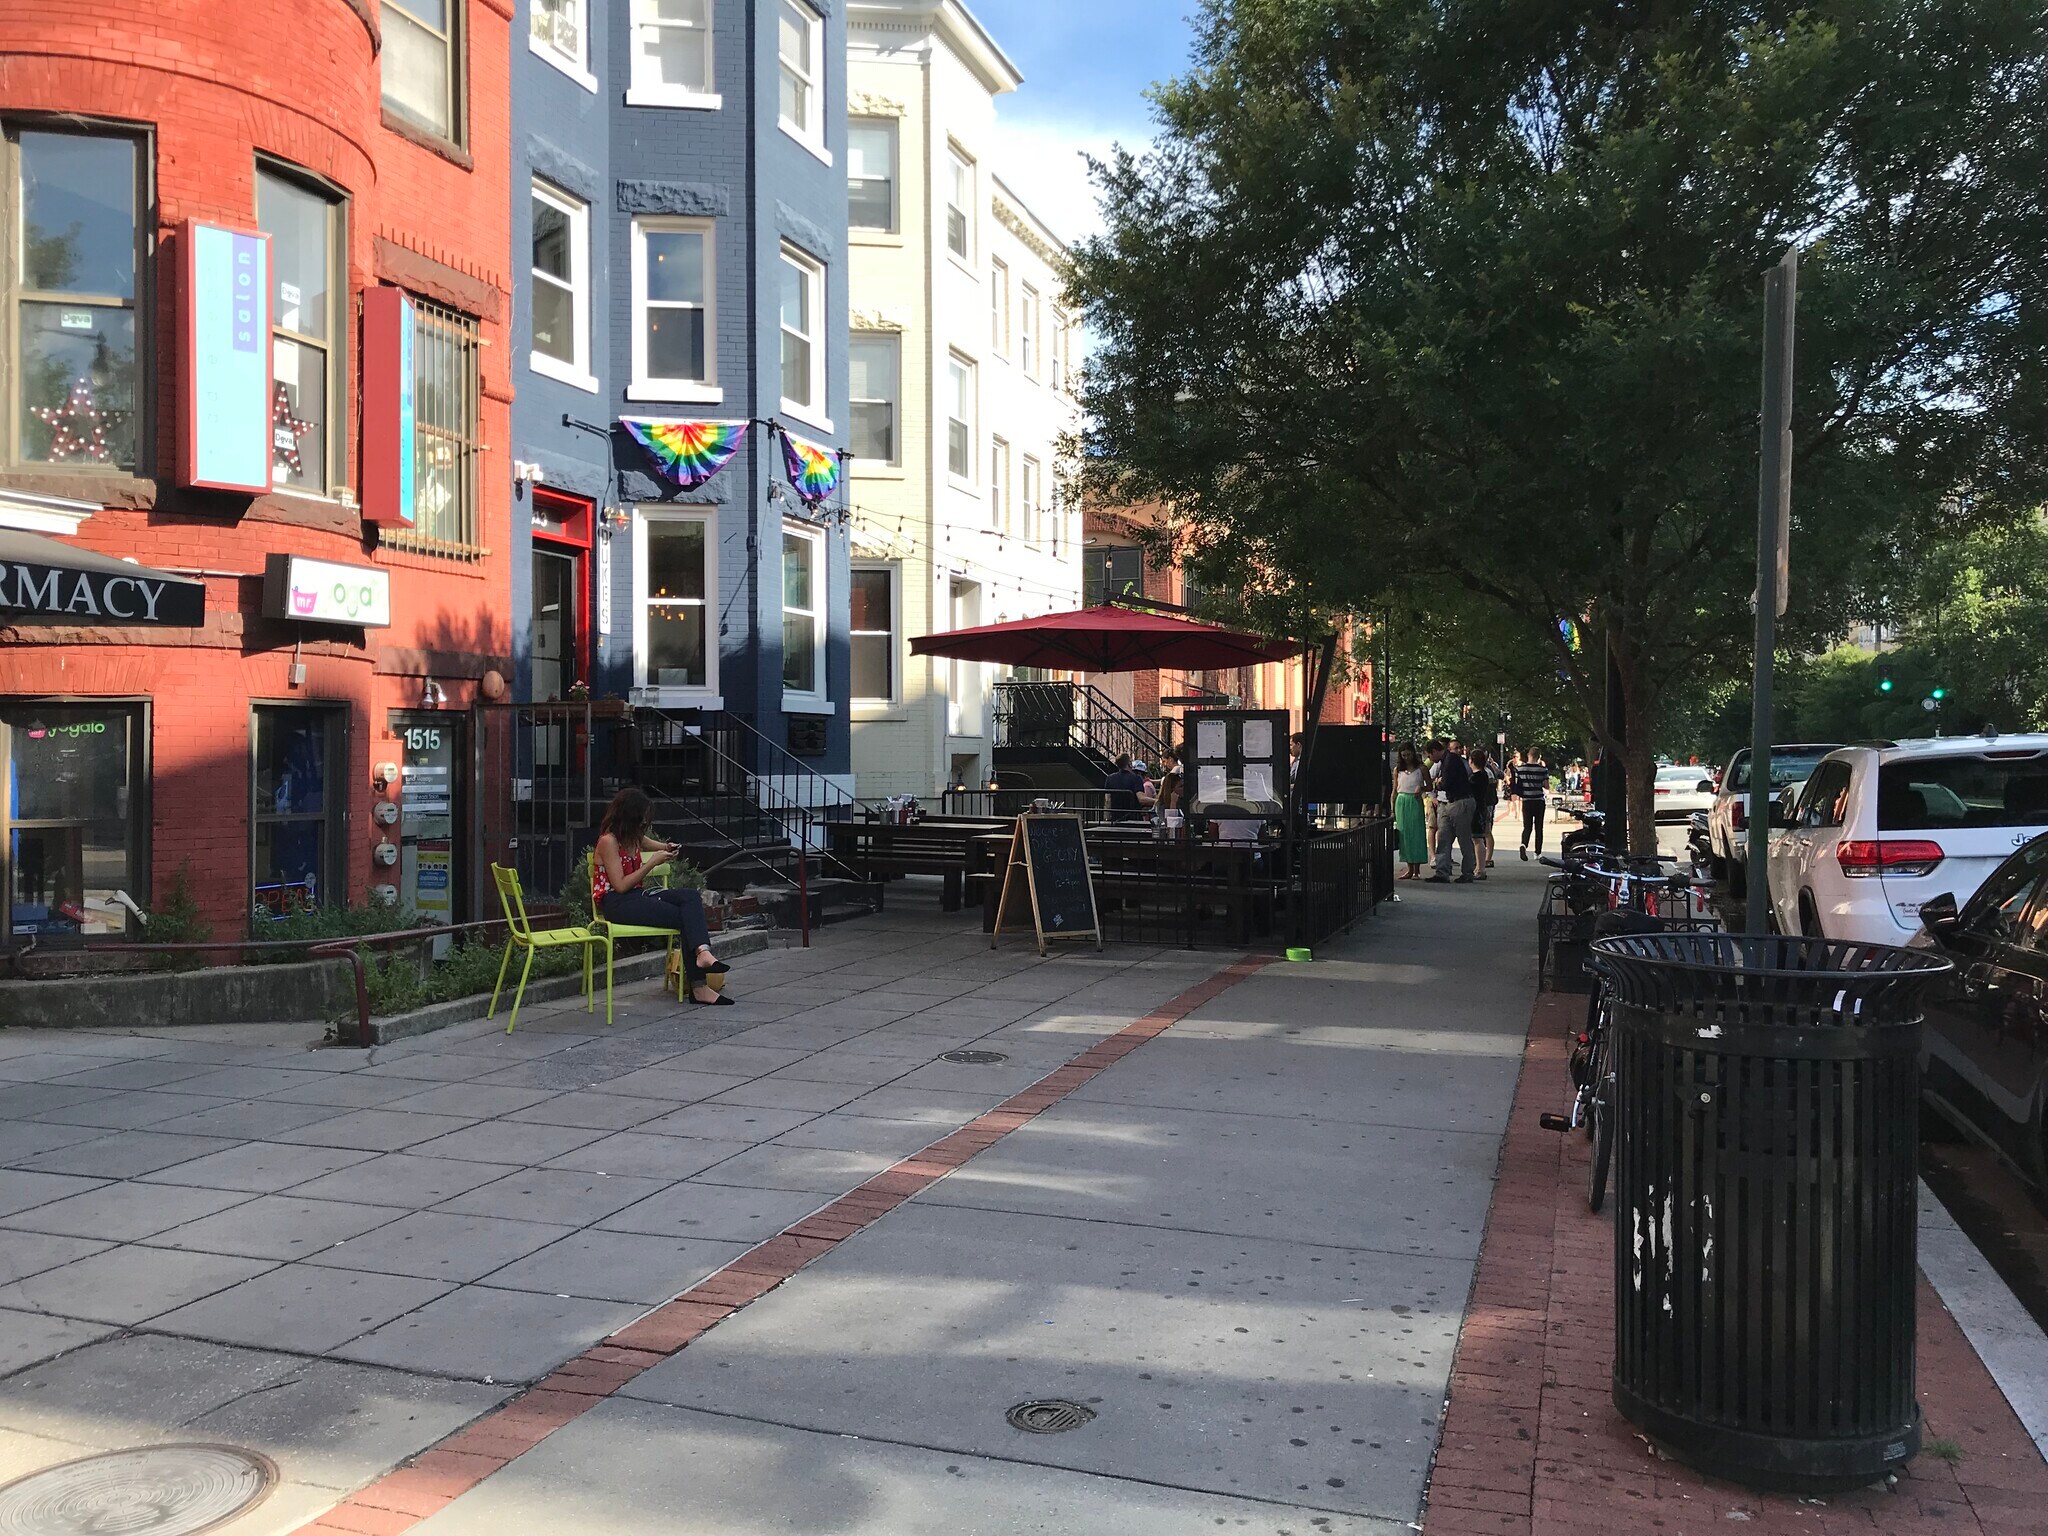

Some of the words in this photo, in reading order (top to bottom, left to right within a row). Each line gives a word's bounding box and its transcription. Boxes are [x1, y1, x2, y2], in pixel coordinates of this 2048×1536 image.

[236, 252, 251, 342] salon
[276, 433, 293, 444] Deva
[404, 728, 440, 750] 1515
[2011, 832, 2034, 846] Je
